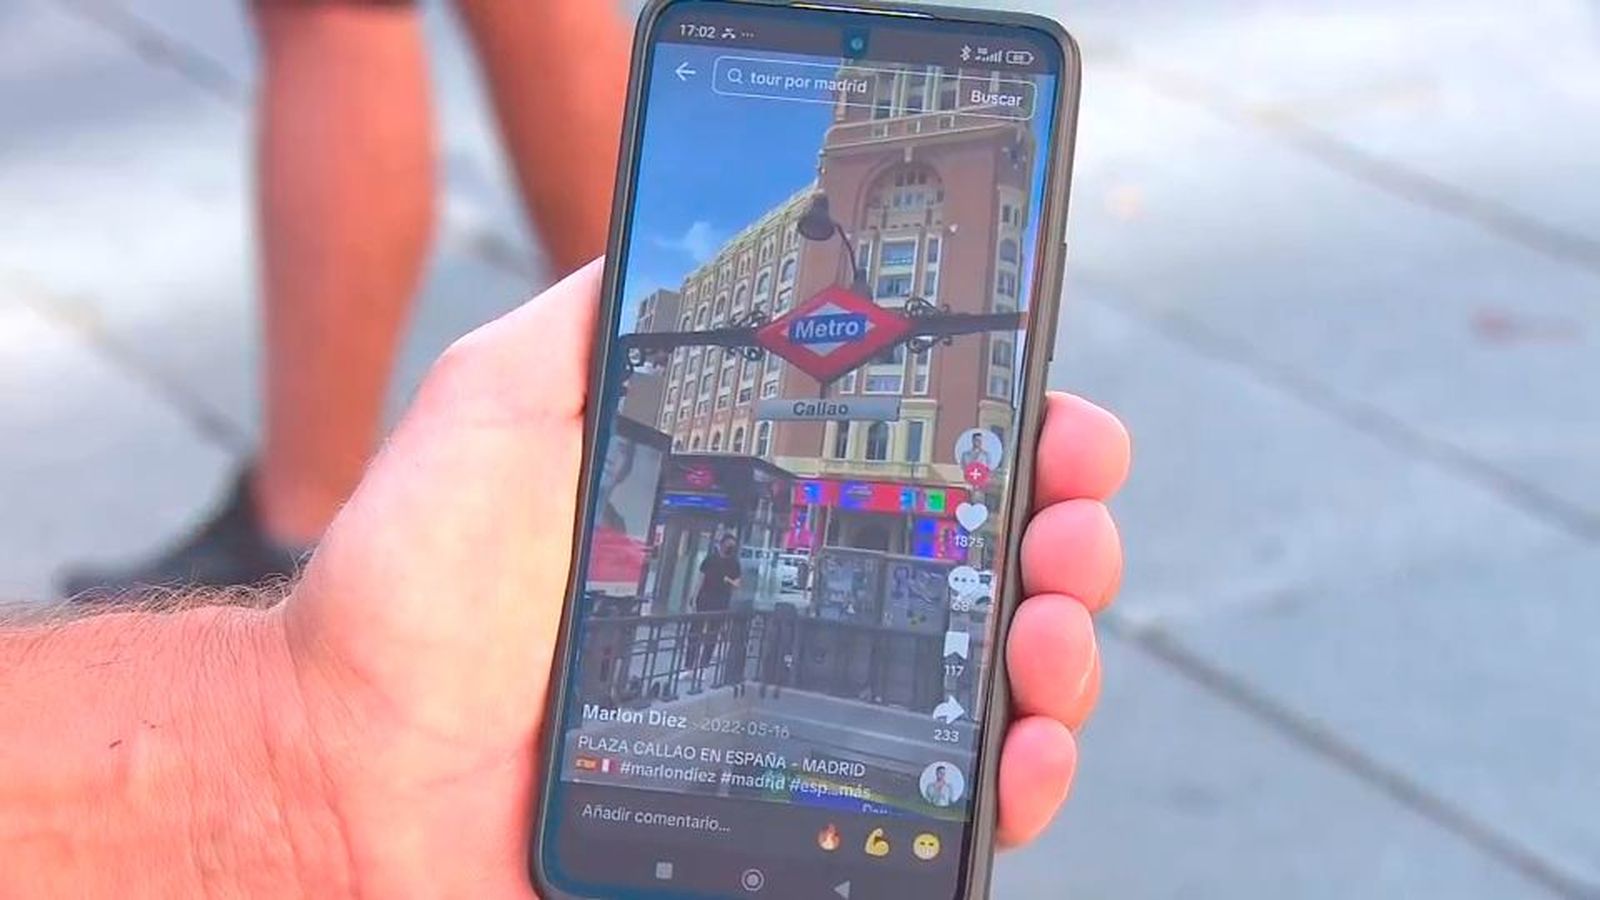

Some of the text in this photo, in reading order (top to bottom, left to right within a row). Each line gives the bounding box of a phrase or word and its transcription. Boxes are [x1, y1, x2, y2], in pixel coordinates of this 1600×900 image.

[679, 24, 716, 39] 17:02
[750, 72, 867, 93] tour por madrid
[970, 89, 1023, 107] Buscar
[794, 319, 859, 339] Metro
[792, 402, 849, 416] Callao
[955, 535, 985, 548] 1875
[944, 664, 964, 677] 117
[583, 704, 644, 724] Marlon
[700, 718, 791, 740] 2022-05-16
[934, 729, 959, 743] 233
[578, 735, 629, 754] PLAZA
[633, 740, 696, 760] CALLAO
[700, 748, 721, 763] EN
[725, 750, 787, 769] ESPAÑA
[802, 758, 866, 777] MADRID
[720, 771, 785, 790] #madrid
[582, 803, 731, 832] Añadir comentario...
